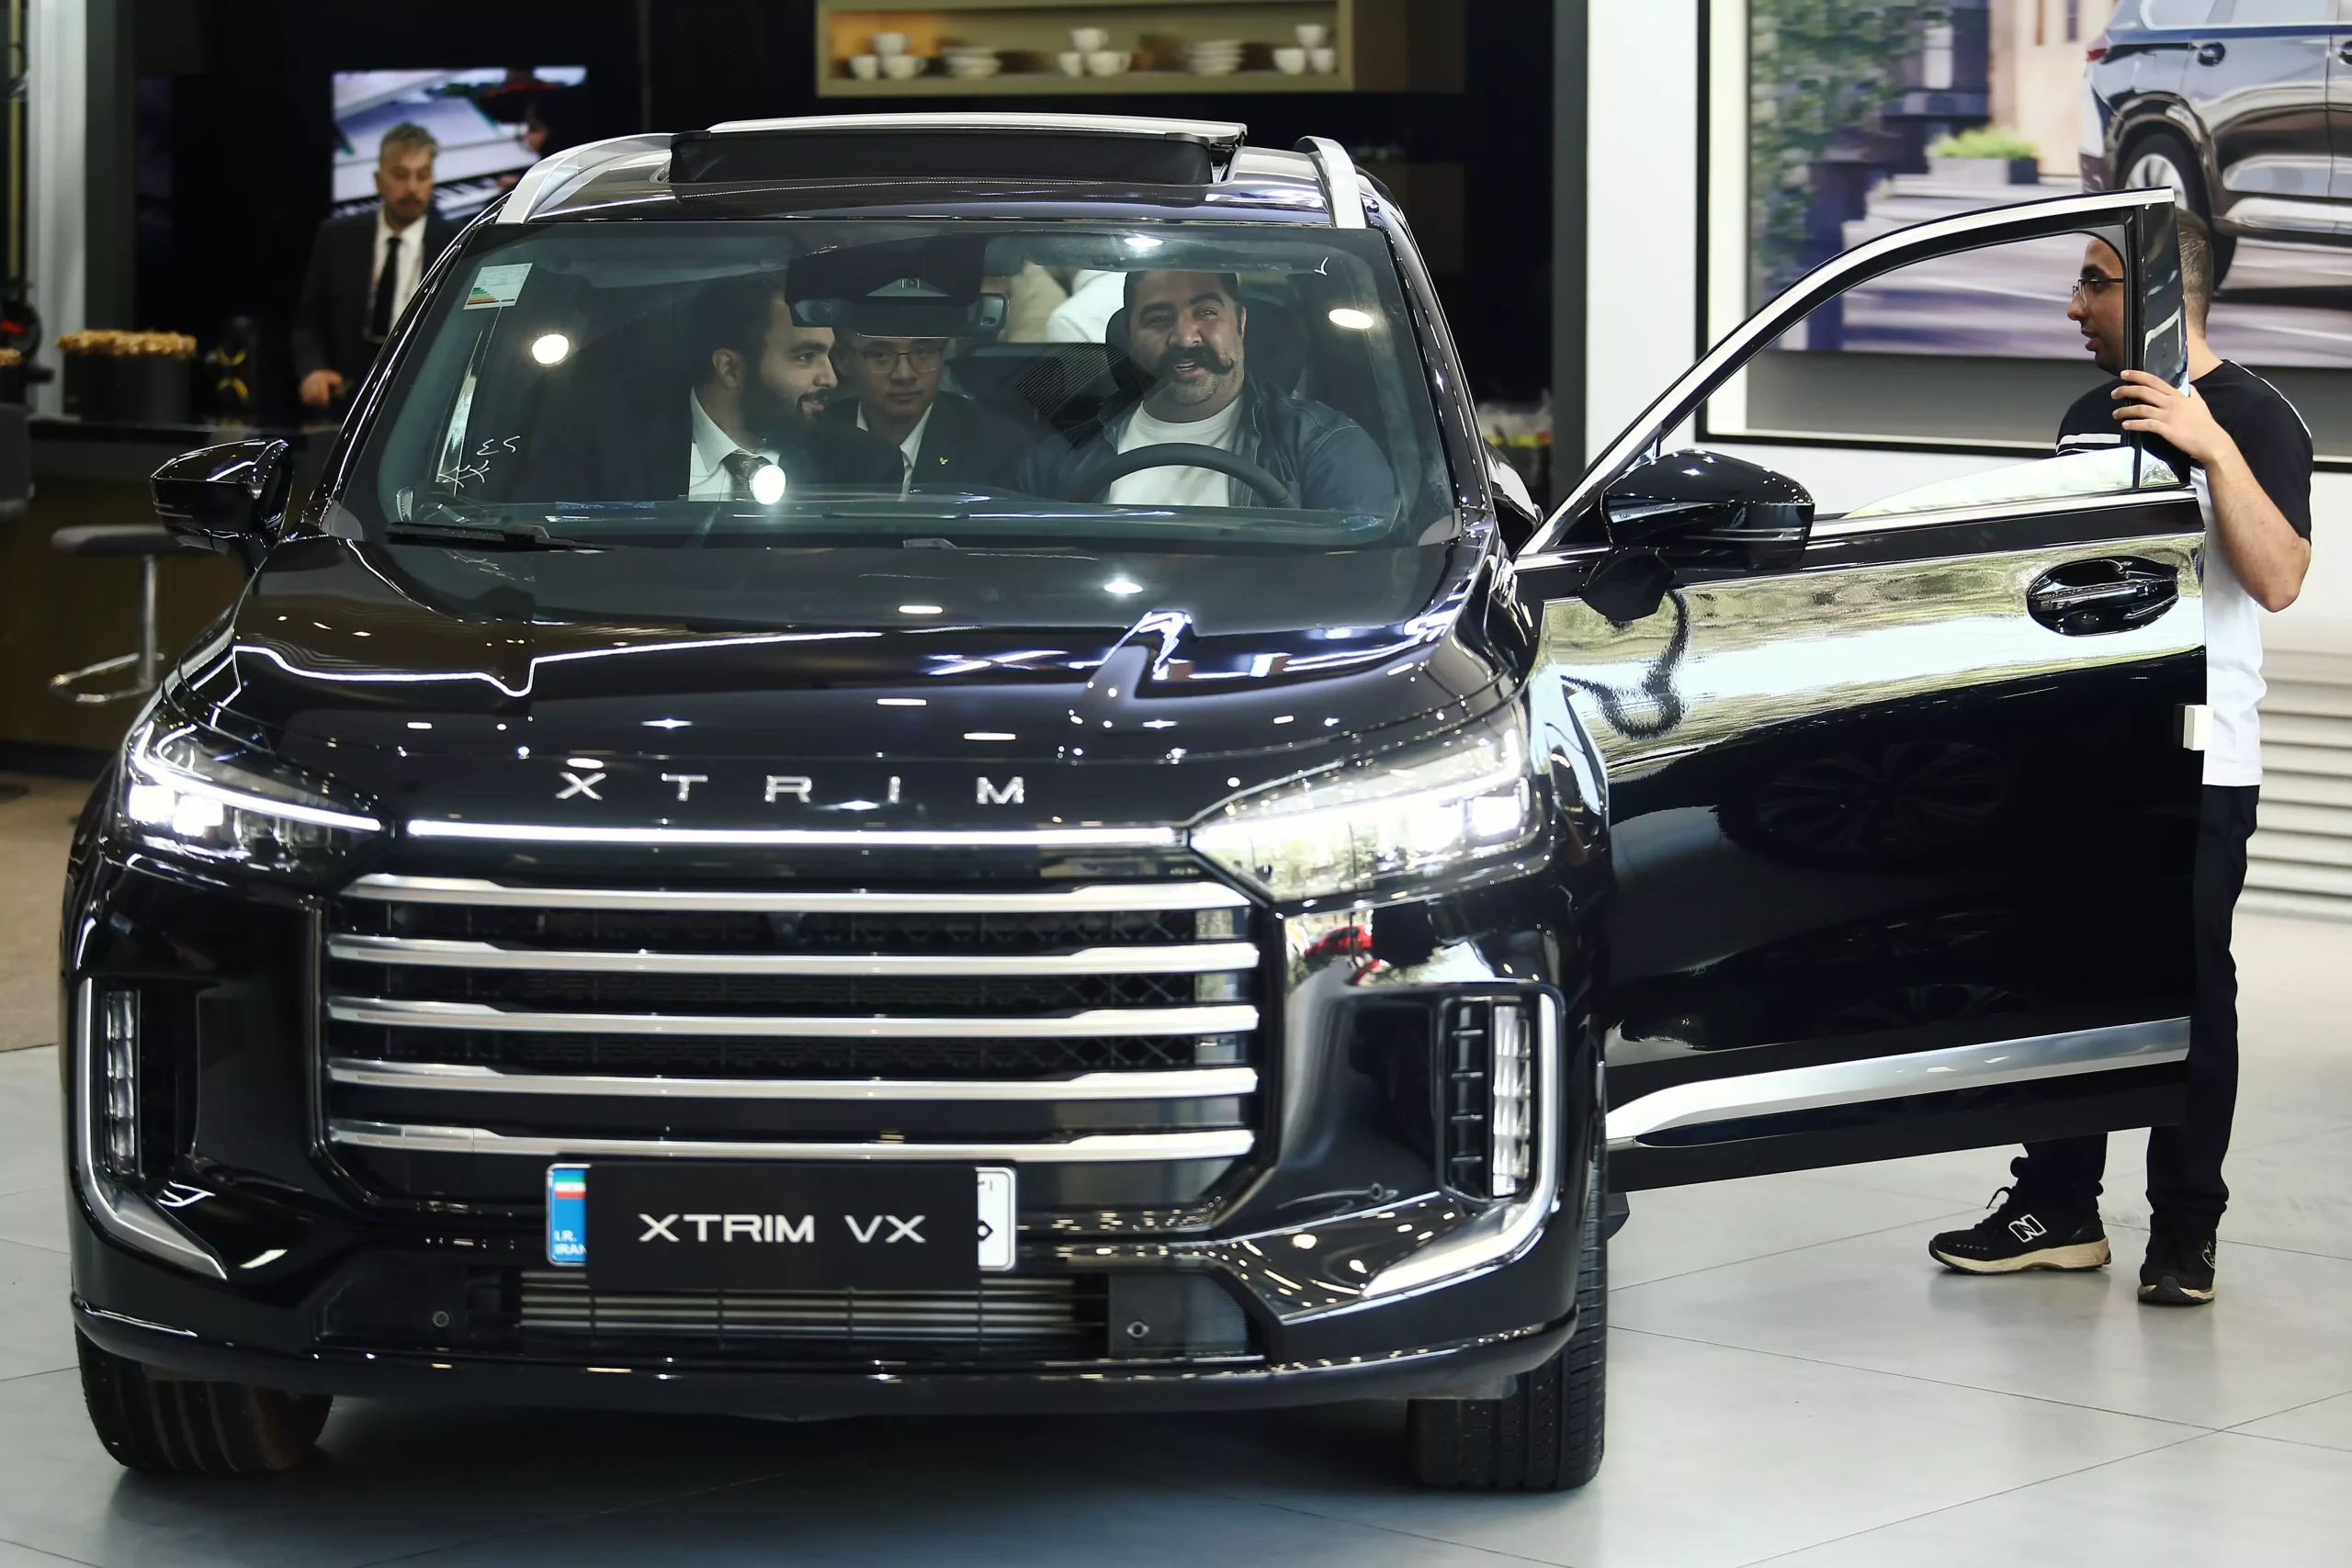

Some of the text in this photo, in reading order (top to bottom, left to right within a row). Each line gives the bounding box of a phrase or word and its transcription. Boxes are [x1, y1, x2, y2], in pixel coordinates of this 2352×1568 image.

[555, 772, 1025, 804] XTRIM
[639, 1213, 926, 1244] XTRIM VX
